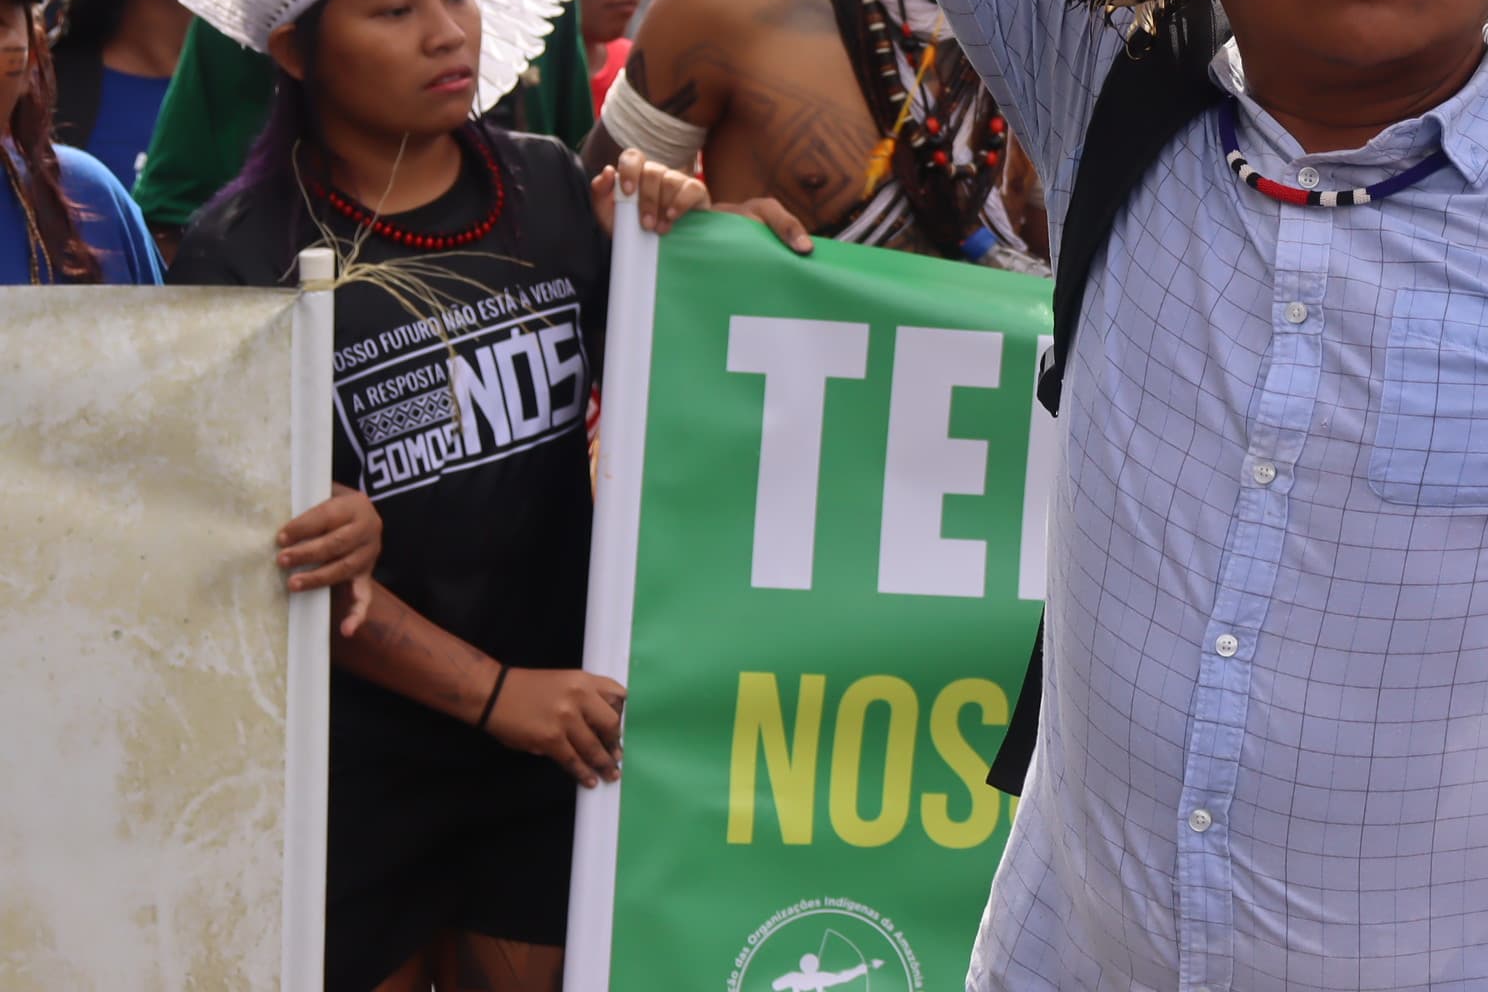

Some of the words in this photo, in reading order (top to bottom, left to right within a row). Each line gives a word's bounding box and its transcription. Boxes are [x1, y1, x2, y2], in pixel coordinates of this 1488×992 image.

[333, 340, 379, 373] OSSO
[379, 316, 442, 354] FUTURO
[442, 303, 477, 333] NÃO
[476, 287, 518, 321] ESTÁ
[530, 277, 577, 305] VENDA
[352, 392, 366, 414] A
[365, 362, 447, 408] RESPOSTA
[367, 421, 464, 490] SOMOS
[447, 326, 582, 457] NÓS
[726, 670, 1020, 851] NOS
[735, 946, 751, 968] das
[747, 897, 822, 946] Organizações
